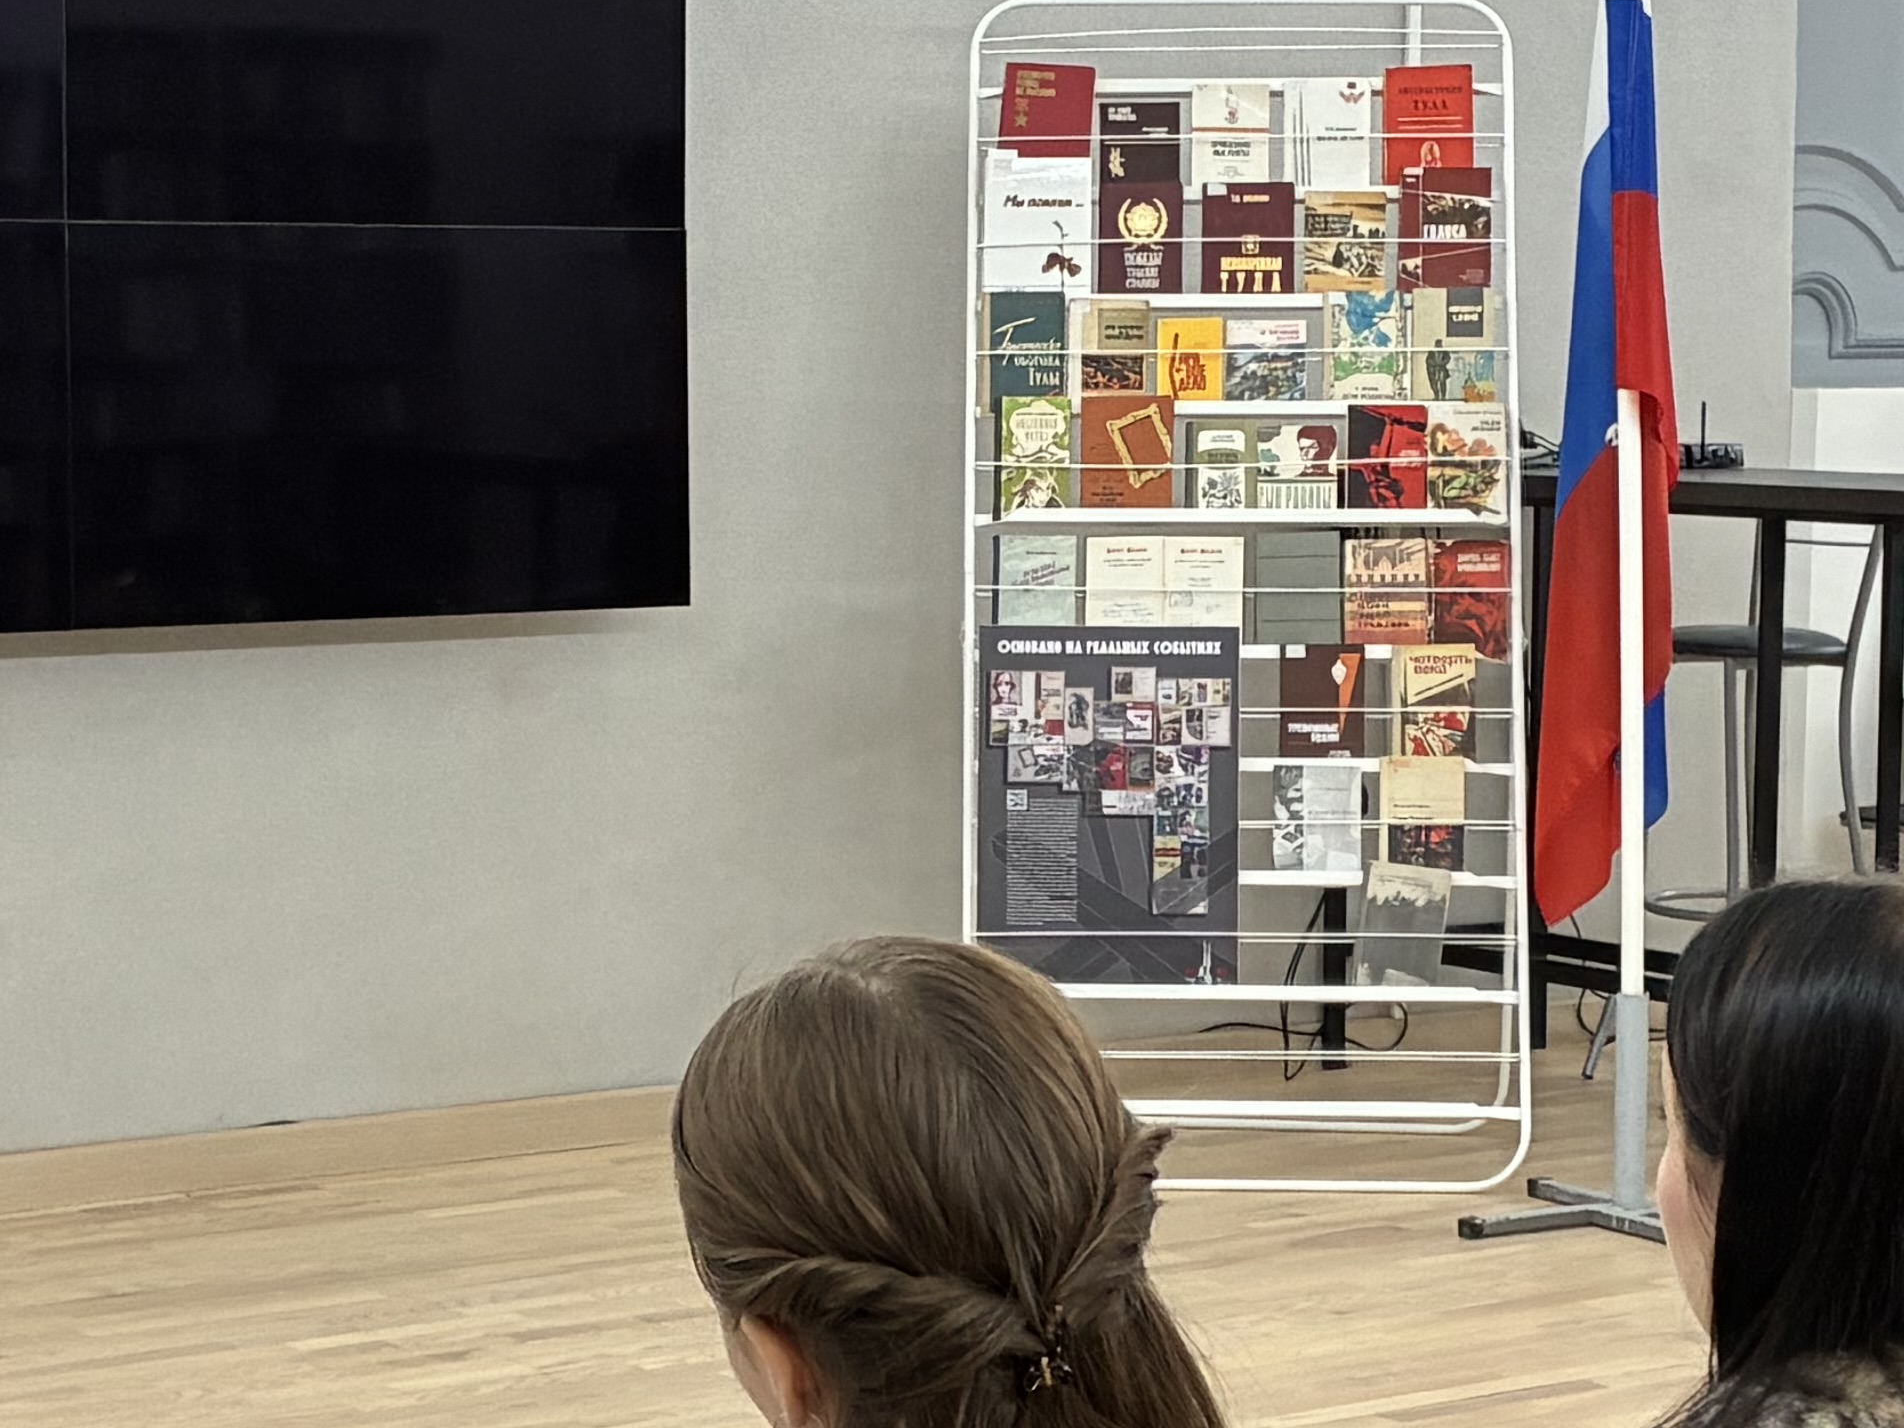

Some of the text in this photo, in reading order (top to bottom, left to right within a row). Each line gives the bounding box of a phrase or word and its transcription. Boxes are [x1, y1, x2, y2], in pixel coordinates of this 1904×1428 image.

[997, 639, 1222, 655] ОСНОВАНО НА РЕАЛЬНЫХ СОБЫТИЯХ
